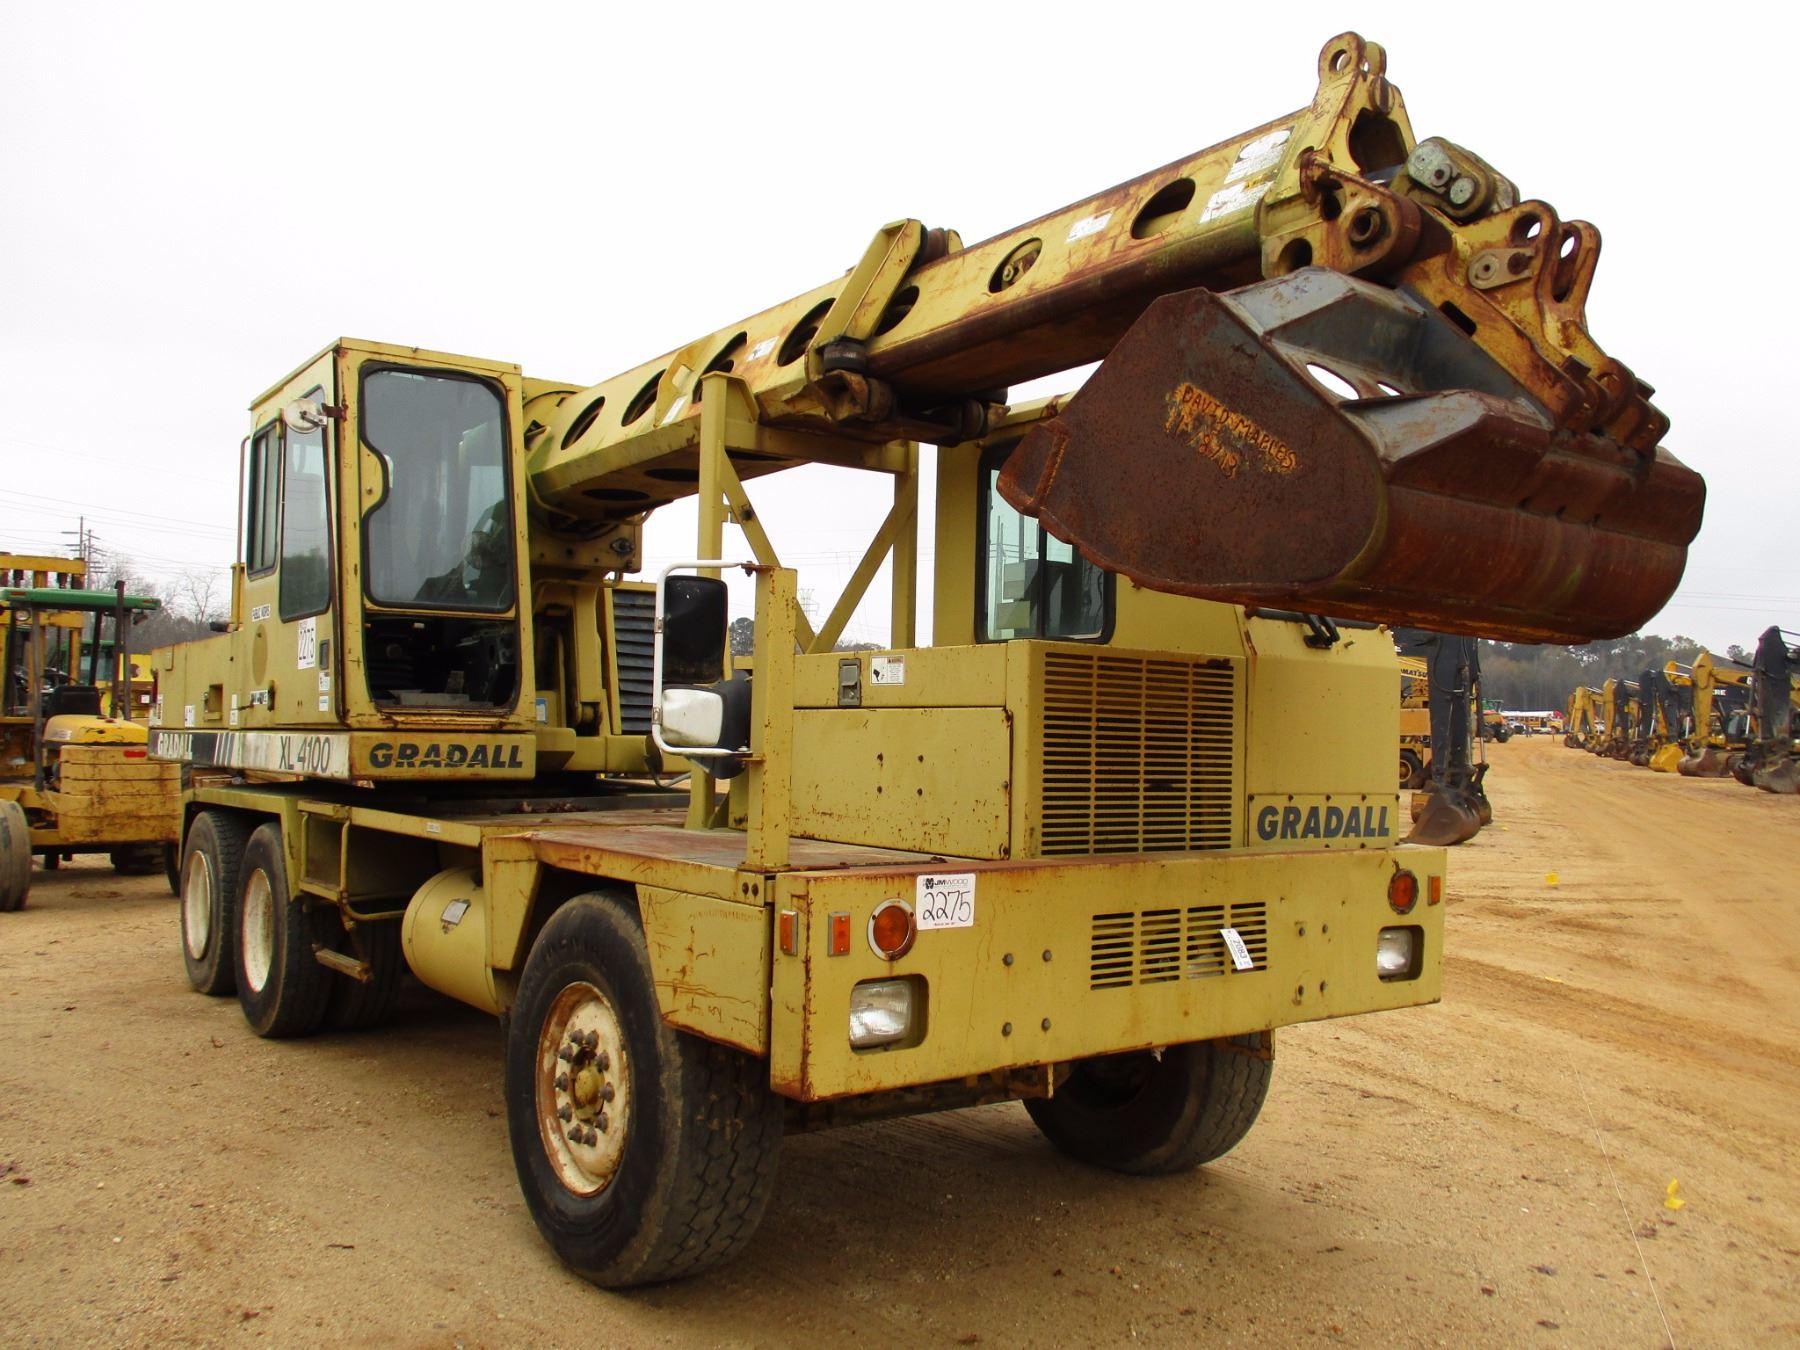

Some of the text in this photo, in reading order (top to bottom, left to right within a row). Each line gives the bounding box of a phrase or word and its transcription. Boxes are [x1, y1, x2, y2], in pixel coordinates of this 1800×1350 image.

[1182, 385, 1229, 425] DAVID
[1233, 418, 1297, 470] MAPLES
[299, 628, 315, 660] 2275
[158, 732, 193, 760] GRADALL
[280, 735, 331, 773] XL 4100
[369, 742, 524, 769] GRADALL
[1257, 805, 1390, 841] GRADALL
[923, 890, 971, 922] 2275
